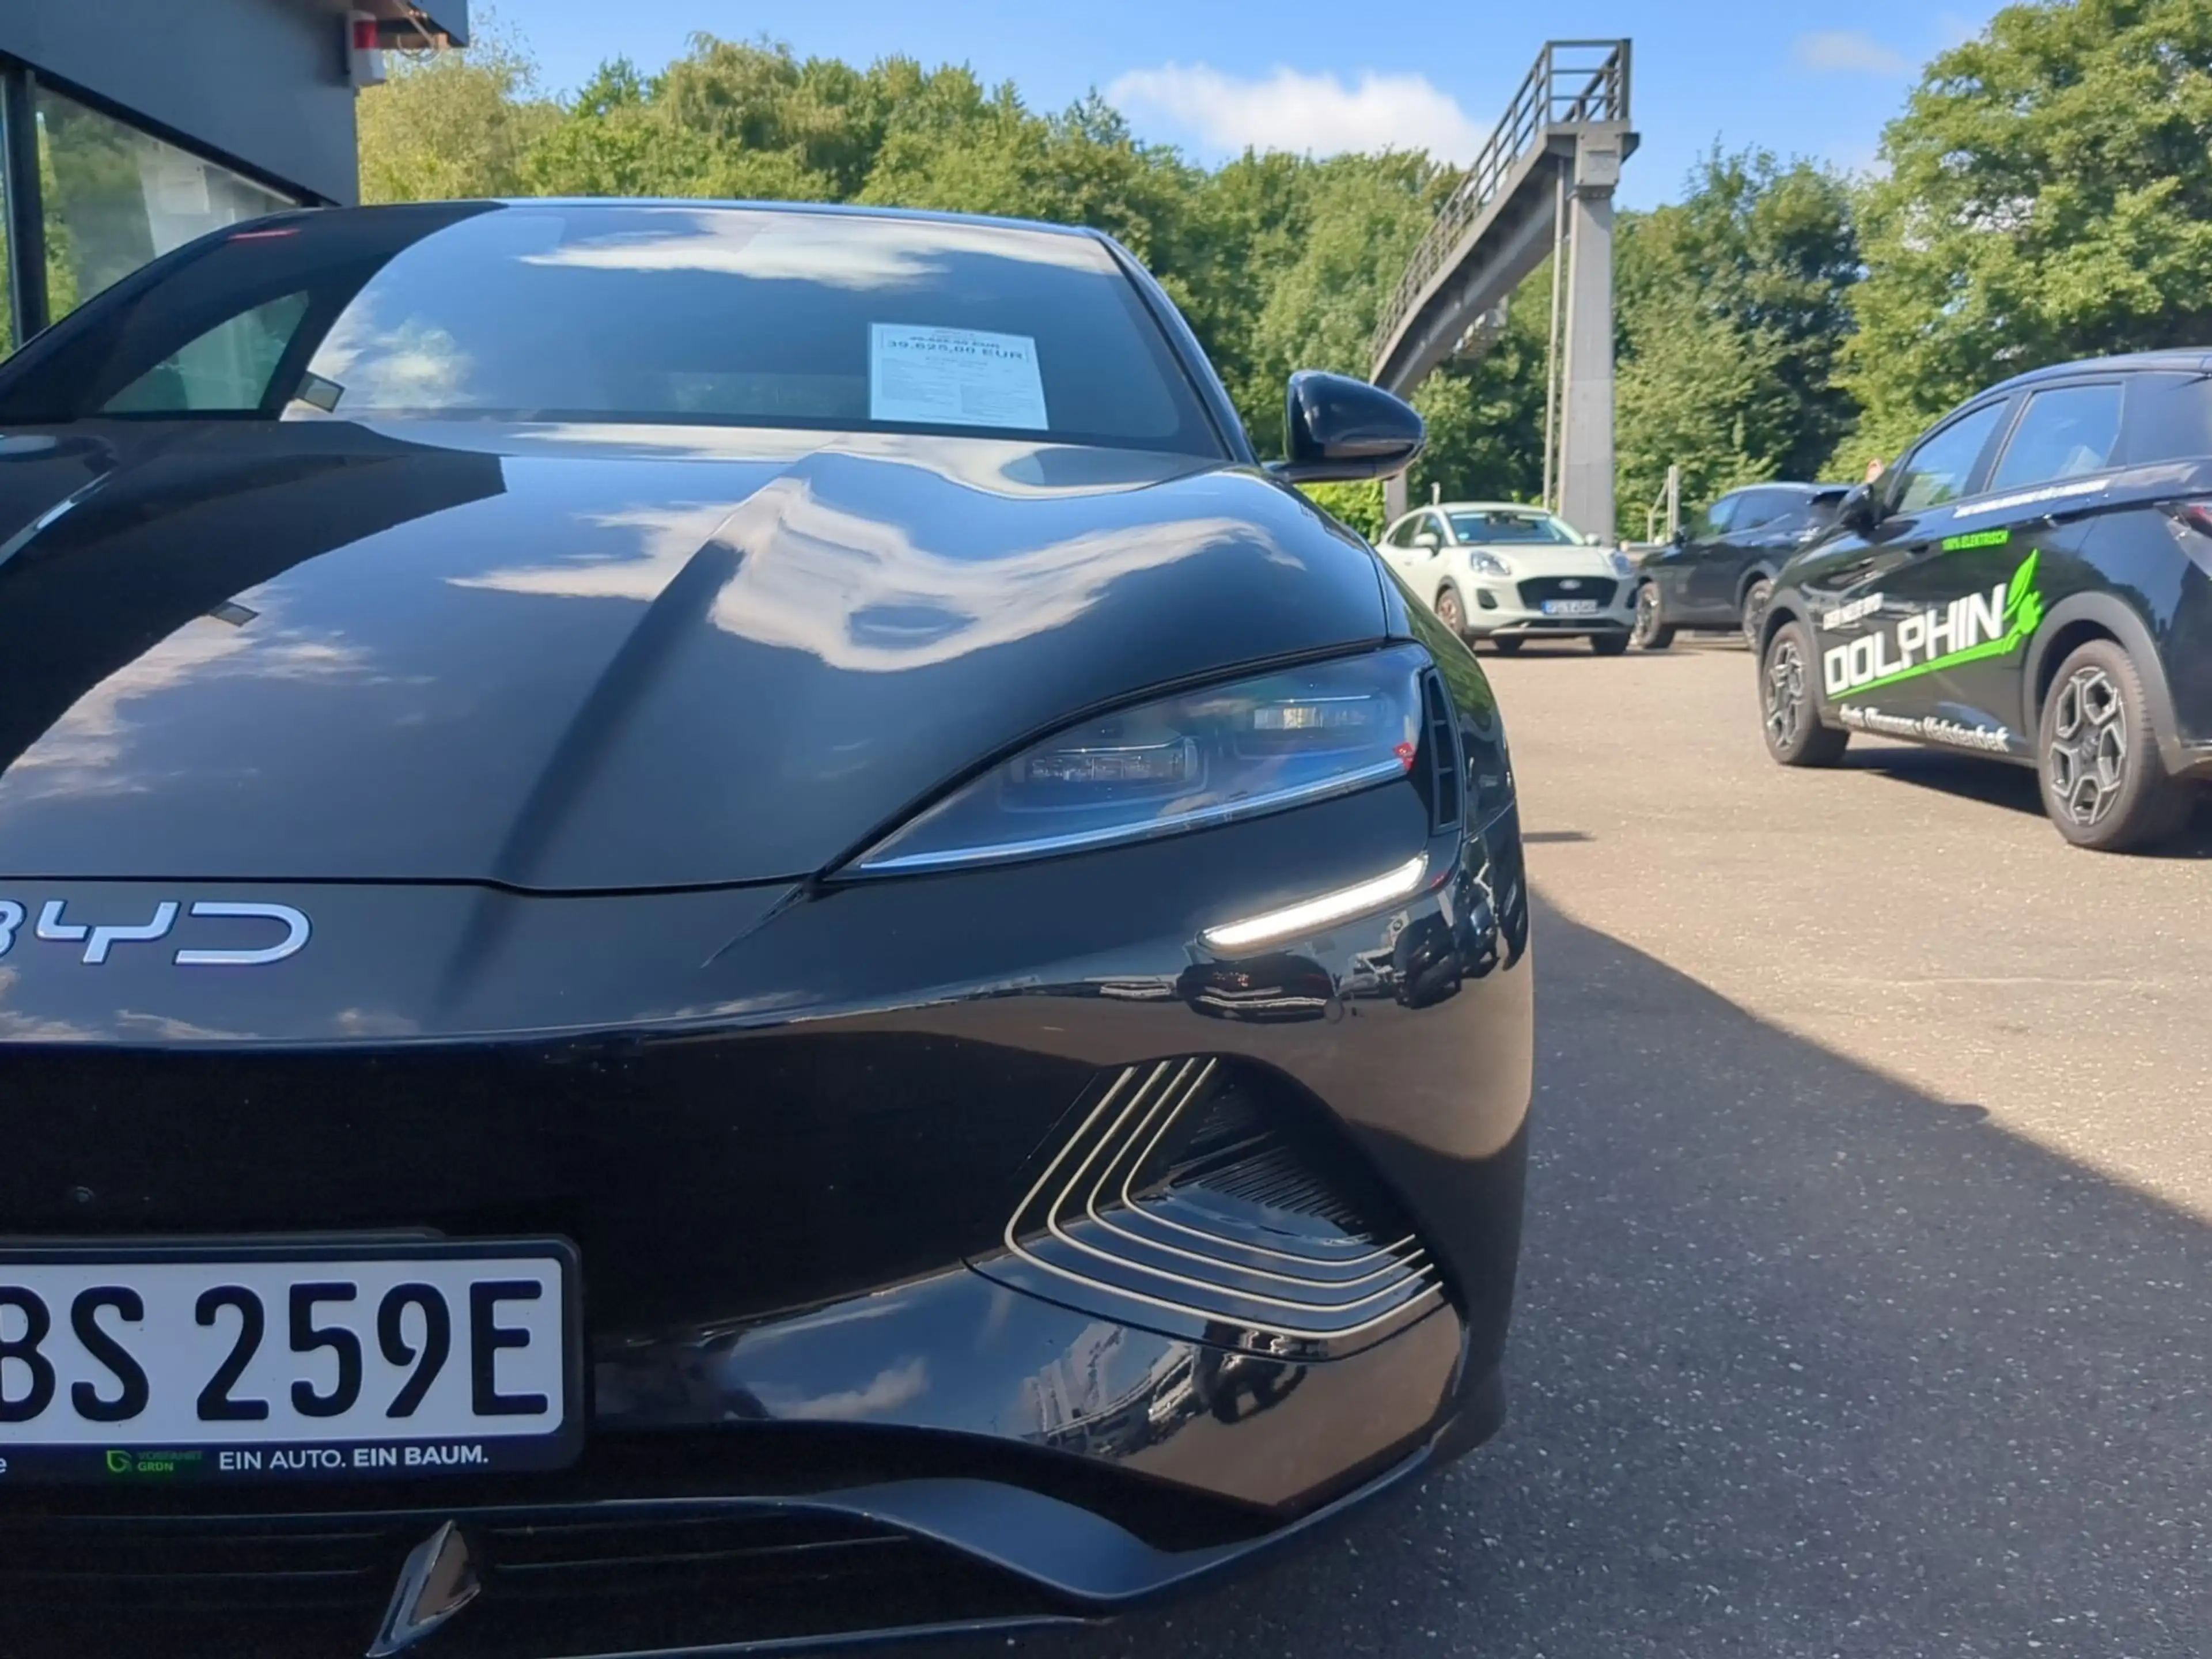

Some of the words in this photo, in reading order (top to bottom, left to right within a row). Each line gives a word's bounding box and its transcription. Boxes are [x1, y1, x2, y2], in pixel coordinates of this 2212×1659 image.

[982, 347, 1023, 360] EUR
[1823, 583, 2008, 695] DOLPHIN
[0, 900, 313, 964] YD
[195, 1279, 548, 1421] 259E
[219, 1451, 262, 1471] EIN
[270, 1449, 346, 1469] AUTO.
[353, 1447, 397, 1467] EIN
[404, 1445, 488, 1466] BAUM.
